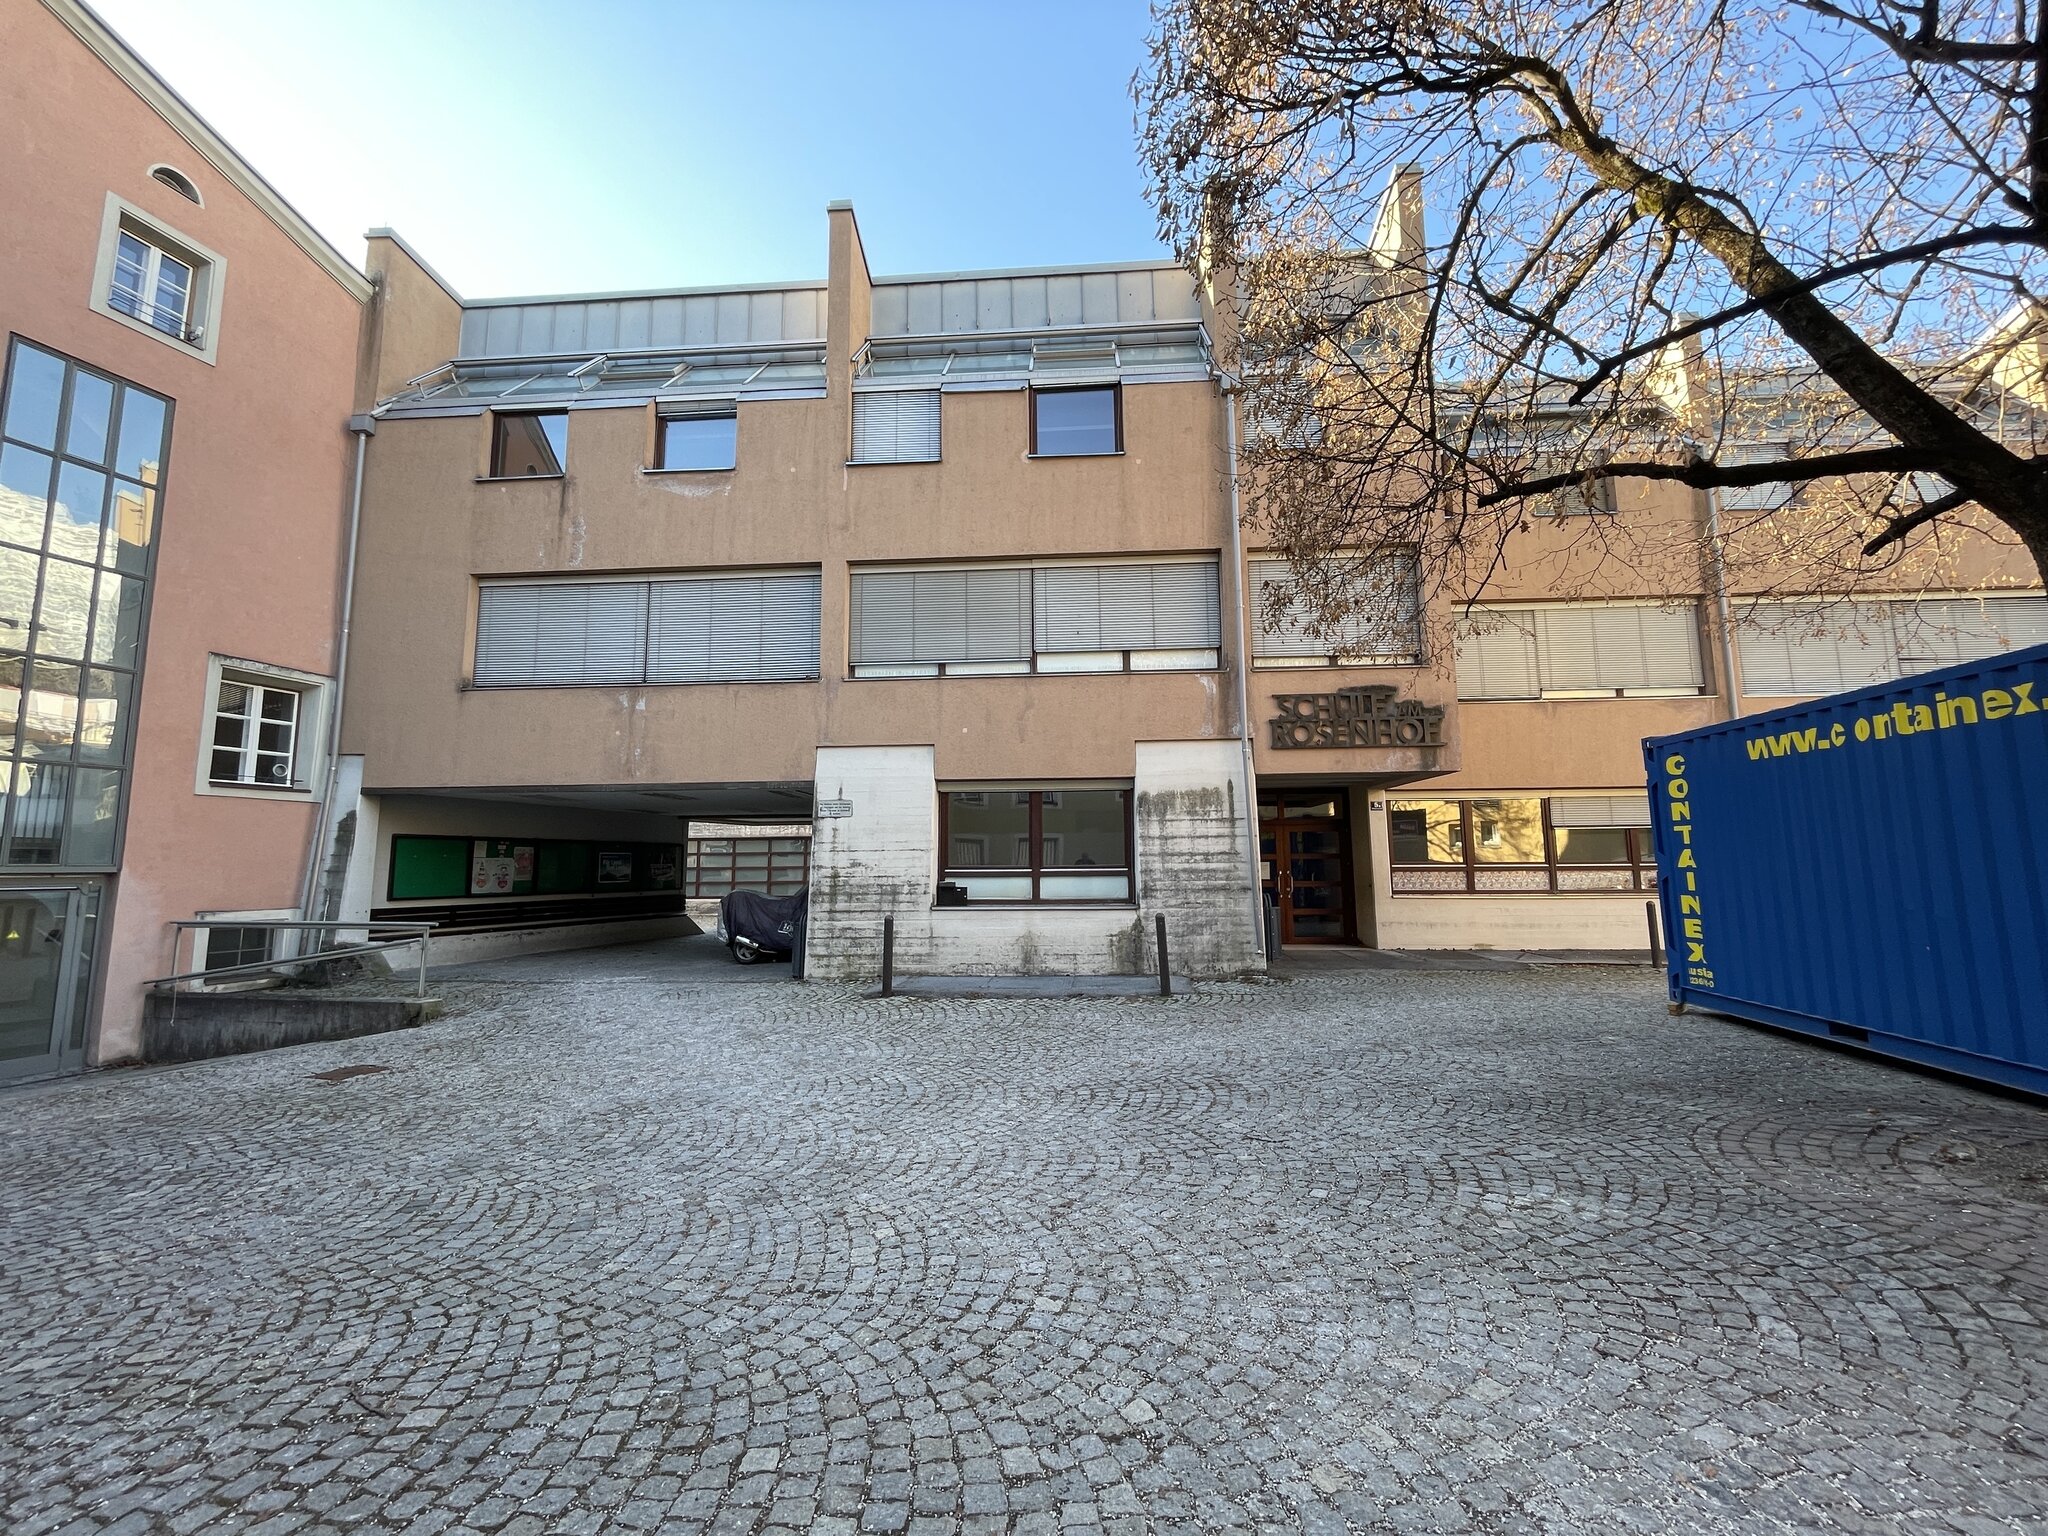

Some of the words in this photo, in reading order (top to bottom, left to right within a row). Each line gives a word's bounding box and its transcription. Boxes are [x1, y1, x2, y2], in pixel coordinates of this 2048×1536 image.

[1275, 693, 1393, 721] SCHULE
[1396, 703, 1421, 718] AM
[1270, 718, 1443, 748] ROSENHOF
[1665, 755, 1708, 964] CONTAINEX
